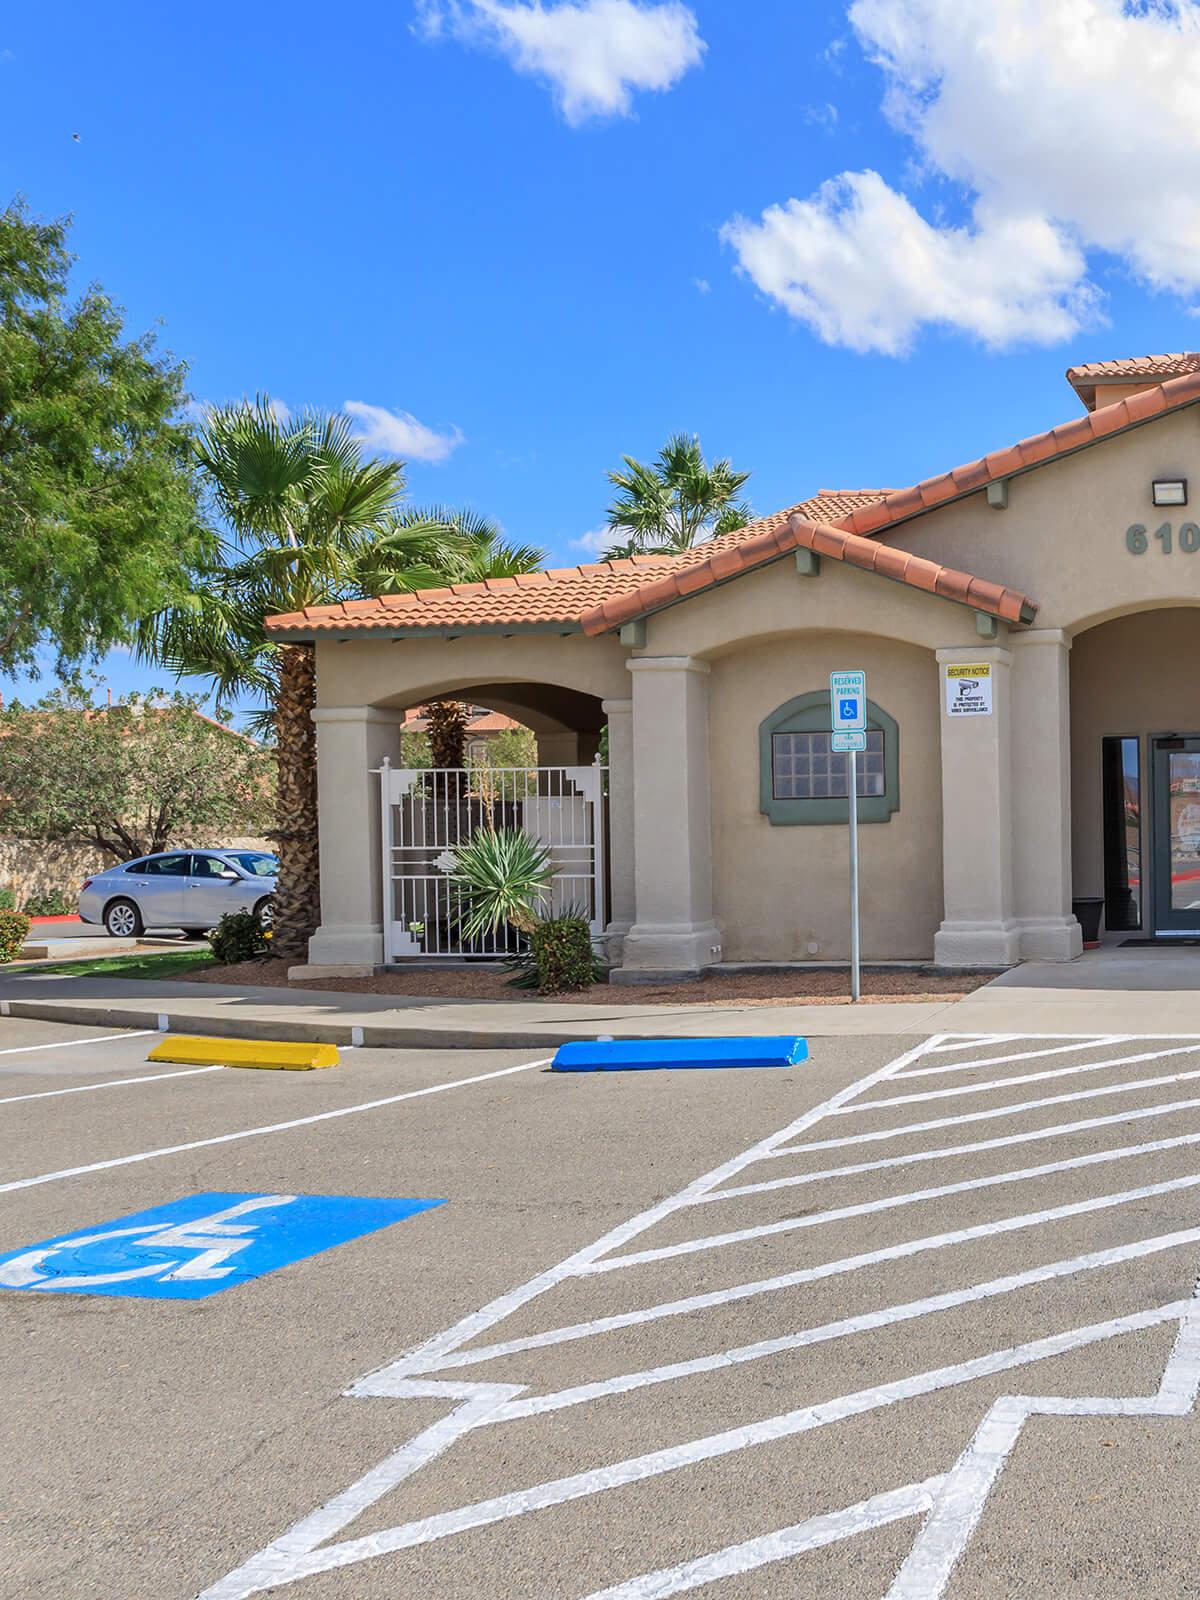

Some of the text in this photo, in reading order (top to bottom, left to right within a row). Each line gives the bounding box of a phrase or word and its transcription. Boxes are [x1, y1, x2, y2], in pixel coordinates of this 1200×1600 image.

[1126, 521, 1200, 555] 610
[947, 667, 990, 676] SECURITY NOTICE
[836, 687, 861, 695] PARKING
